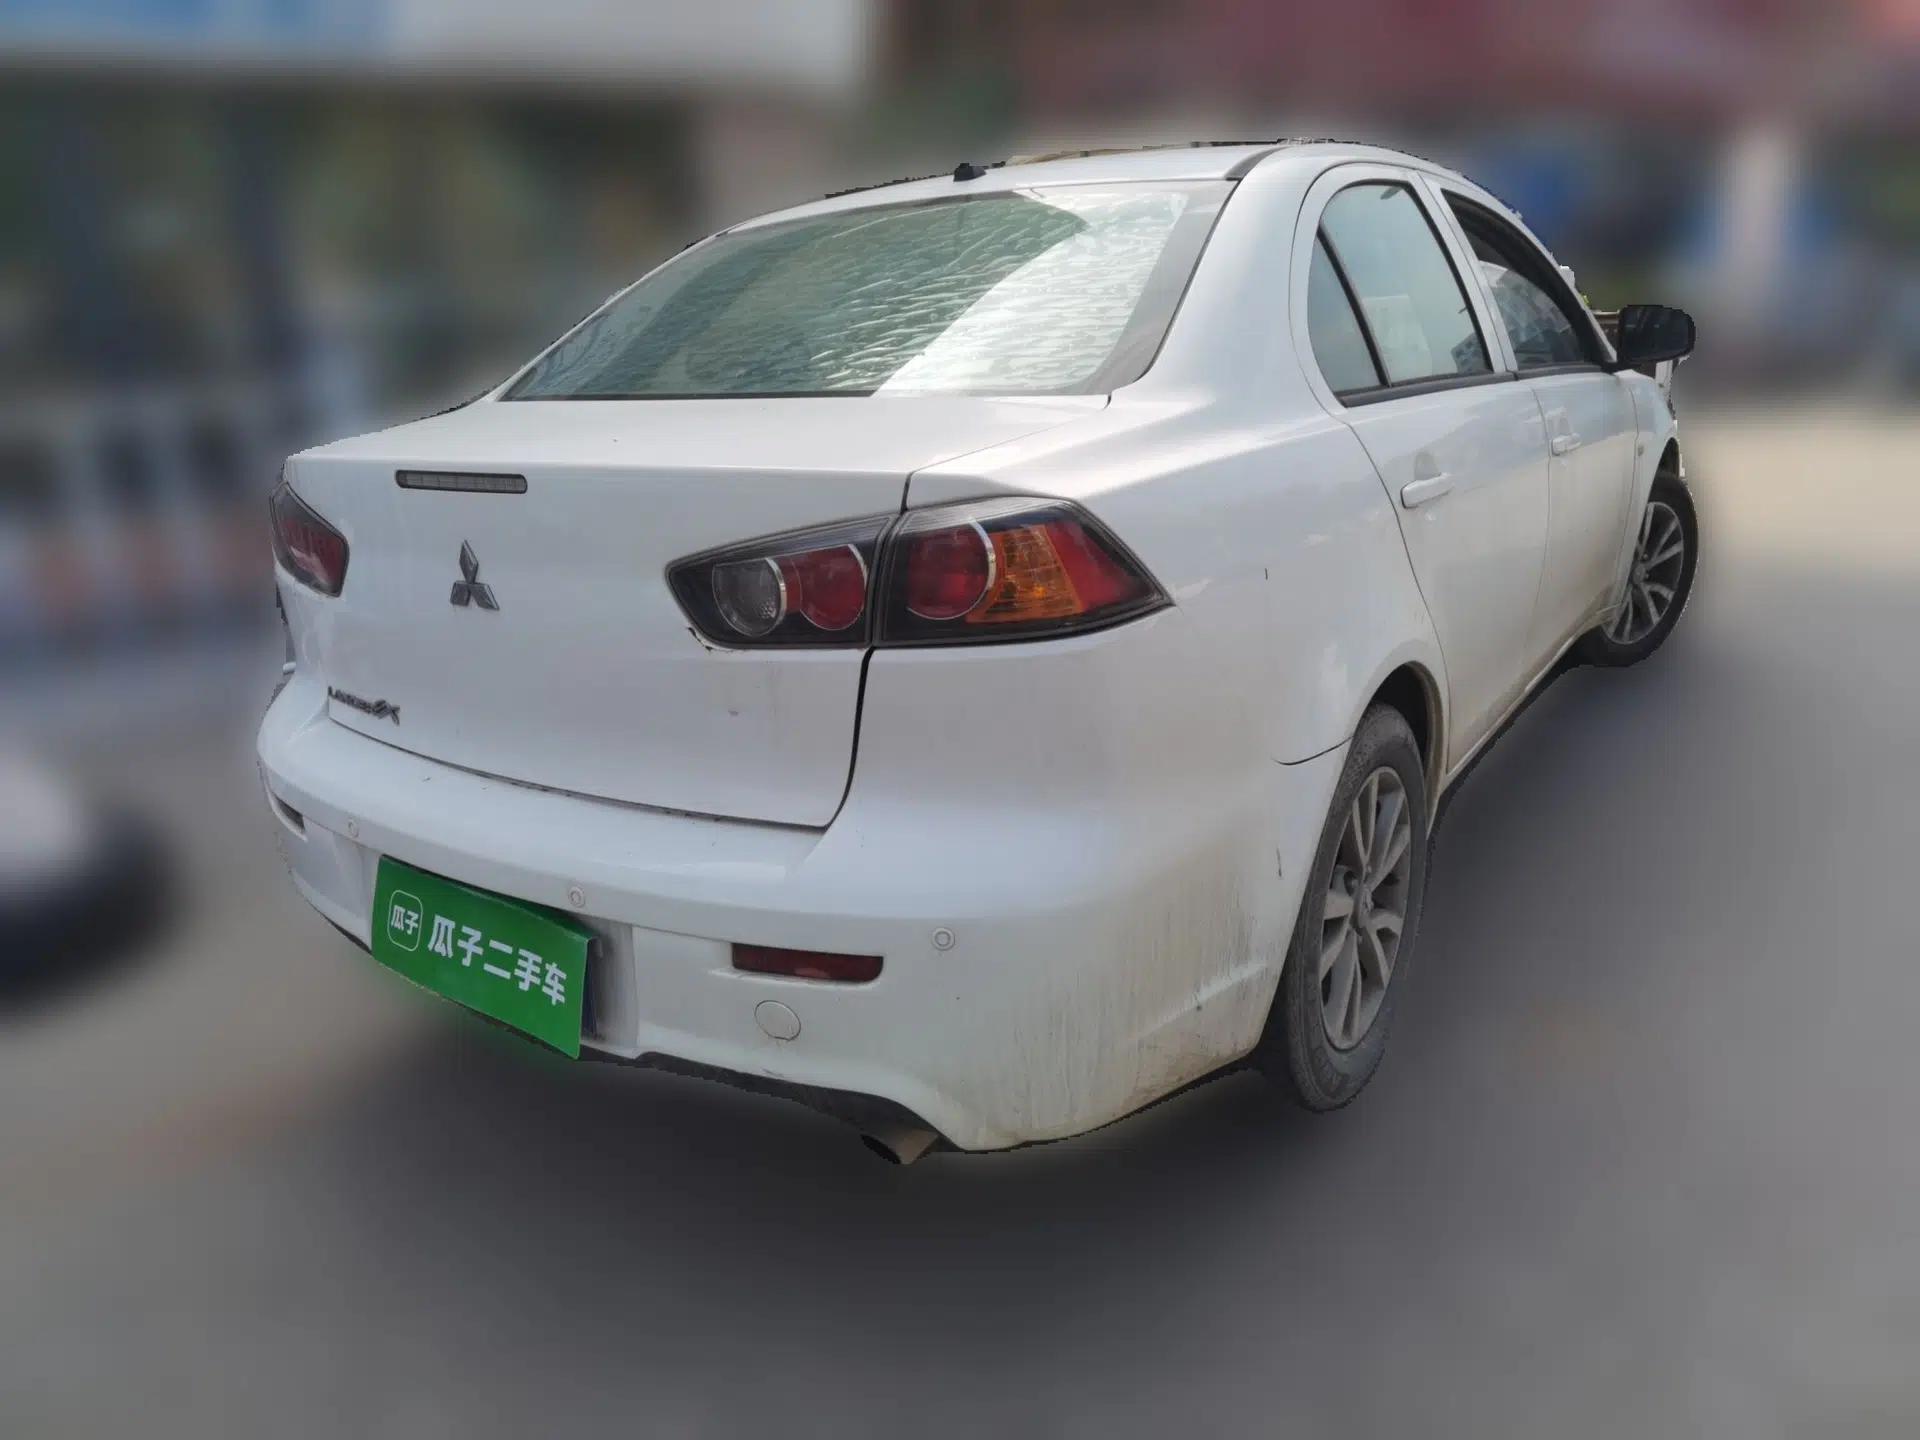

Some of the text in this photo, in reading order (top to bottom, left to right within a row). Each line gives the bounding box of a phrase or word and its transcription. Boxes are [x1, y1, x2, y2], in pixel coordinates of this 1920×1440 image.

[391, 904, 567, 1006] 瓜子 瓜子二手车
